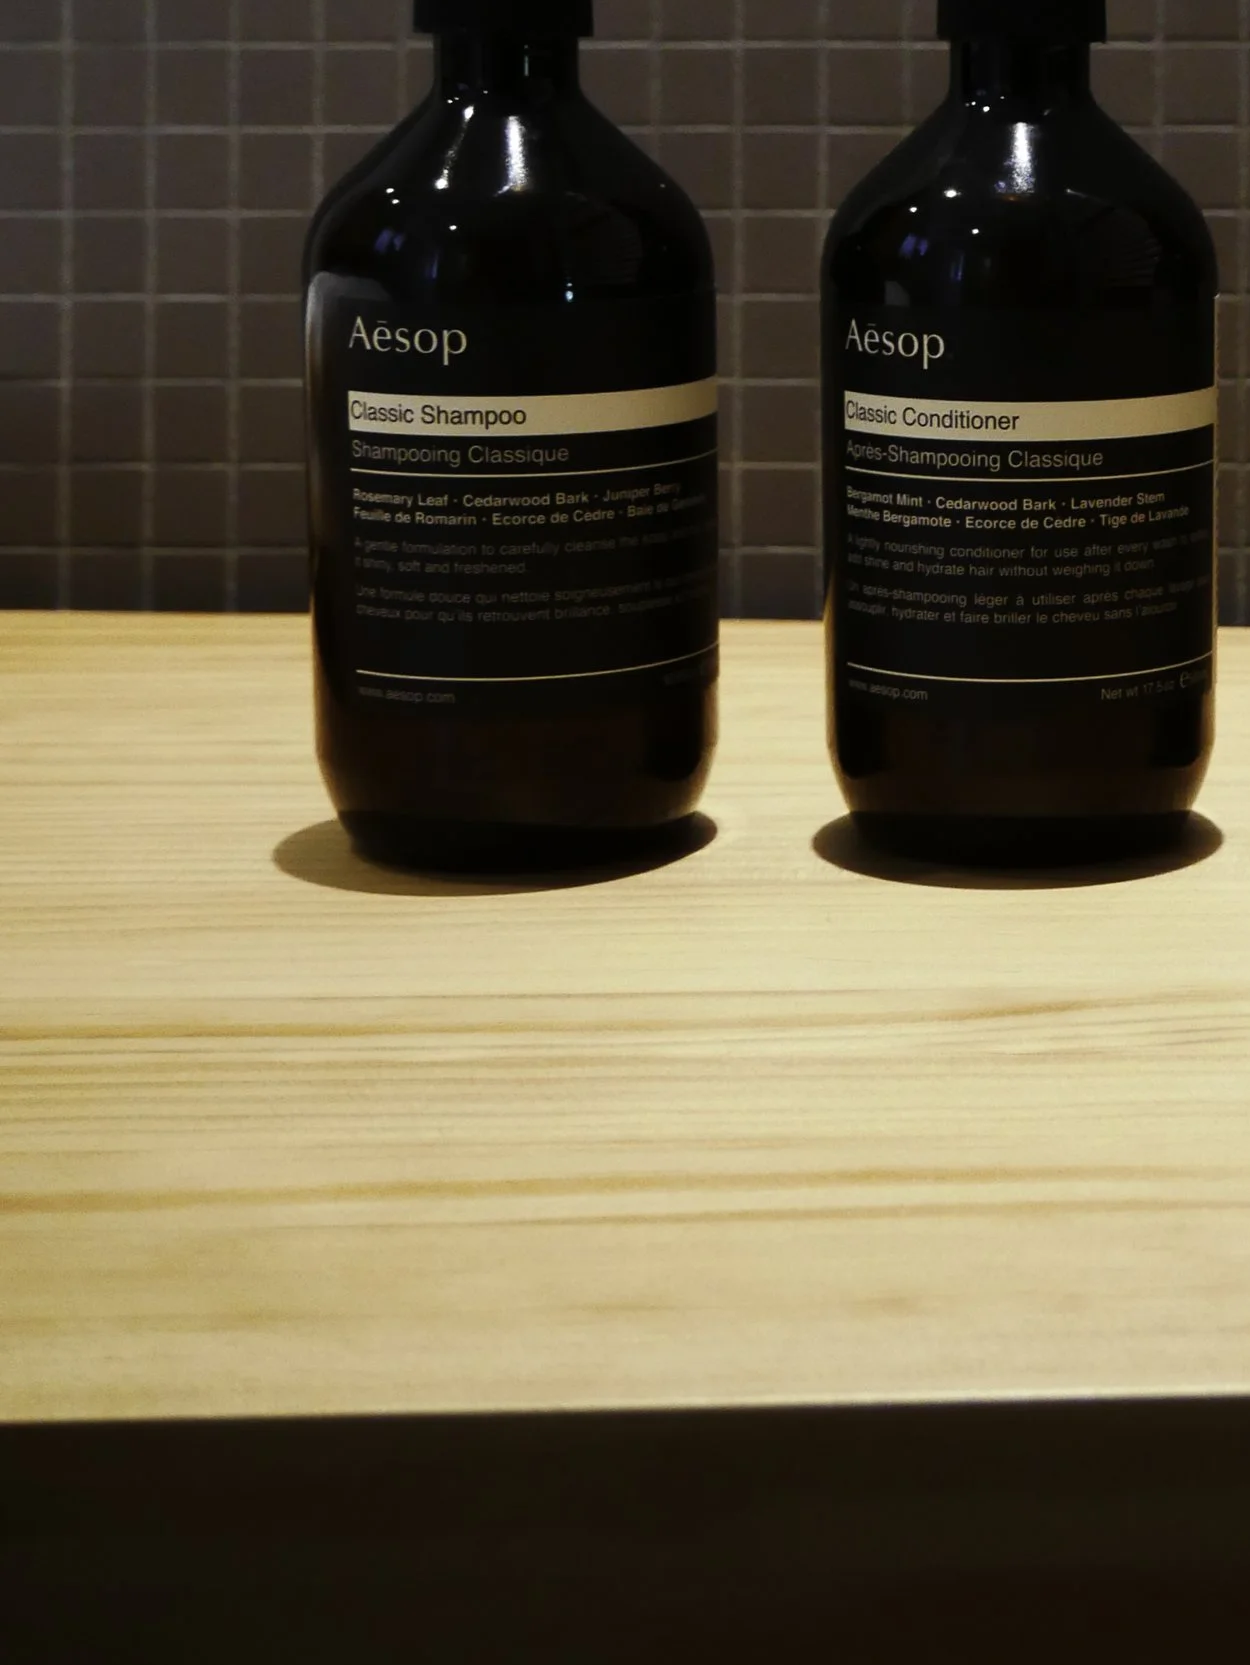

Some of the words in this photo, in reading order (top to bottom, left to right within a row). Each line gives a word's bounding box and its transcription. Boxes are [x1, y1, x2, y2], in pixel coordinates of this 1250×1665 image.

[347, 315, 468, 367] Aēsop
[845, 317, 946, 370] Aēsop
[351, 400, 414, 423] Classic
[421, 404, 527, 430] Shampoo
[846, 400, 897, 425] Classic
[902, 406, 1020, 430] Conditioner
[351, 439, 462, 468] Shampooing
[467, 443, 569, 467] Classique
[1008, 449, 1104, 471] Classique
[352, 488, 414, 508] Rosemary
[417, 493, 449, 507] Leaf
[462, 493, 550, 508] Cedarwood
[555, 491, 589, 505] Bark
[602, 488, 650, 503] Juniper
[846, 485, 893, 504] Bergamot
[897, 493, 924, 508] Mint
[935, 496, 1018, 511] Cedarwood
[1022, 498, 1056, 511] Bark
[1071, 496, 1133, 510] Lavender
[1136, 492, 1165, 505] Stem
[394, 511, 411, 524] de
[415, 511, 477, 525] Romarin
[492, 512, 546, 526] Ecorce
[550, 510, 569, 524] de
[882, 509, 952, 528] Bergamote
[965, 516, 1017, 529] Ecorce
[1020, 517, 1039, 530] de
[1100, 513, 1128, 529] Tige
[1130, 511, 1146, 524] de
[481, 543, 495, 556] to
[949, 544, 1025, 559] conditioner
[1030, 545, 1048, 559] for
[1054, 547, 1079, 558] use
[424, 561, 449, 574] and
[917, 561, 965, 576] hydrate
[999, 565, 1048, 577] without
[1052, 562, 1111, 579] weighing
[960, 610, 989, 623] faire
[1052, 611, 1100, 624] cheveu
